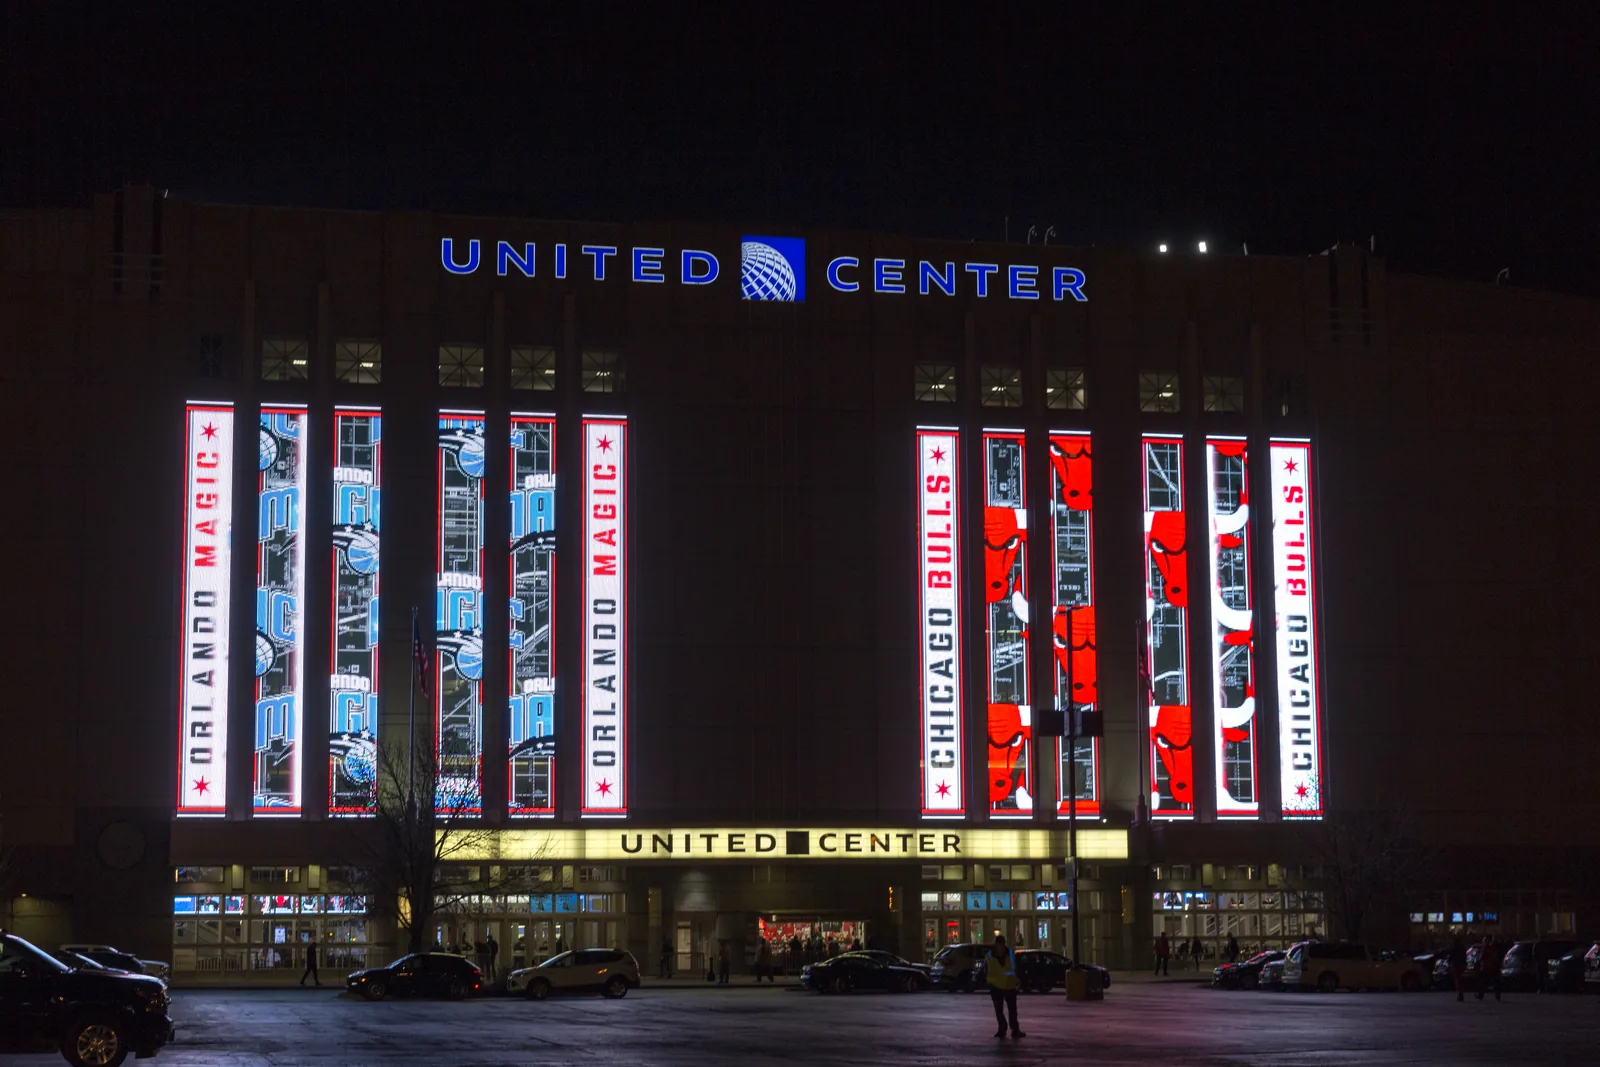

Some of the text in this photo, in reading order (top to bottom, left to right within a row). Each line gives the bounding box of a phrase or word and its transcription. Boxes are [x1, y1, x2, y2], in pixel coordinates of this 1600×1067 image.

[441, 238, 1089, 302] UNITED CENTER
[190, 451, 219, 765] ORLANDO MAGIC
[592, 463, 617, 768] ORLANDO MAGIC
[925, 475, 955, 769] CHICAGO BULLS
[1283, 485, 1313, 771] CHICAGO BULLS
[621, 832, 962, 853] UNITED CENTER
